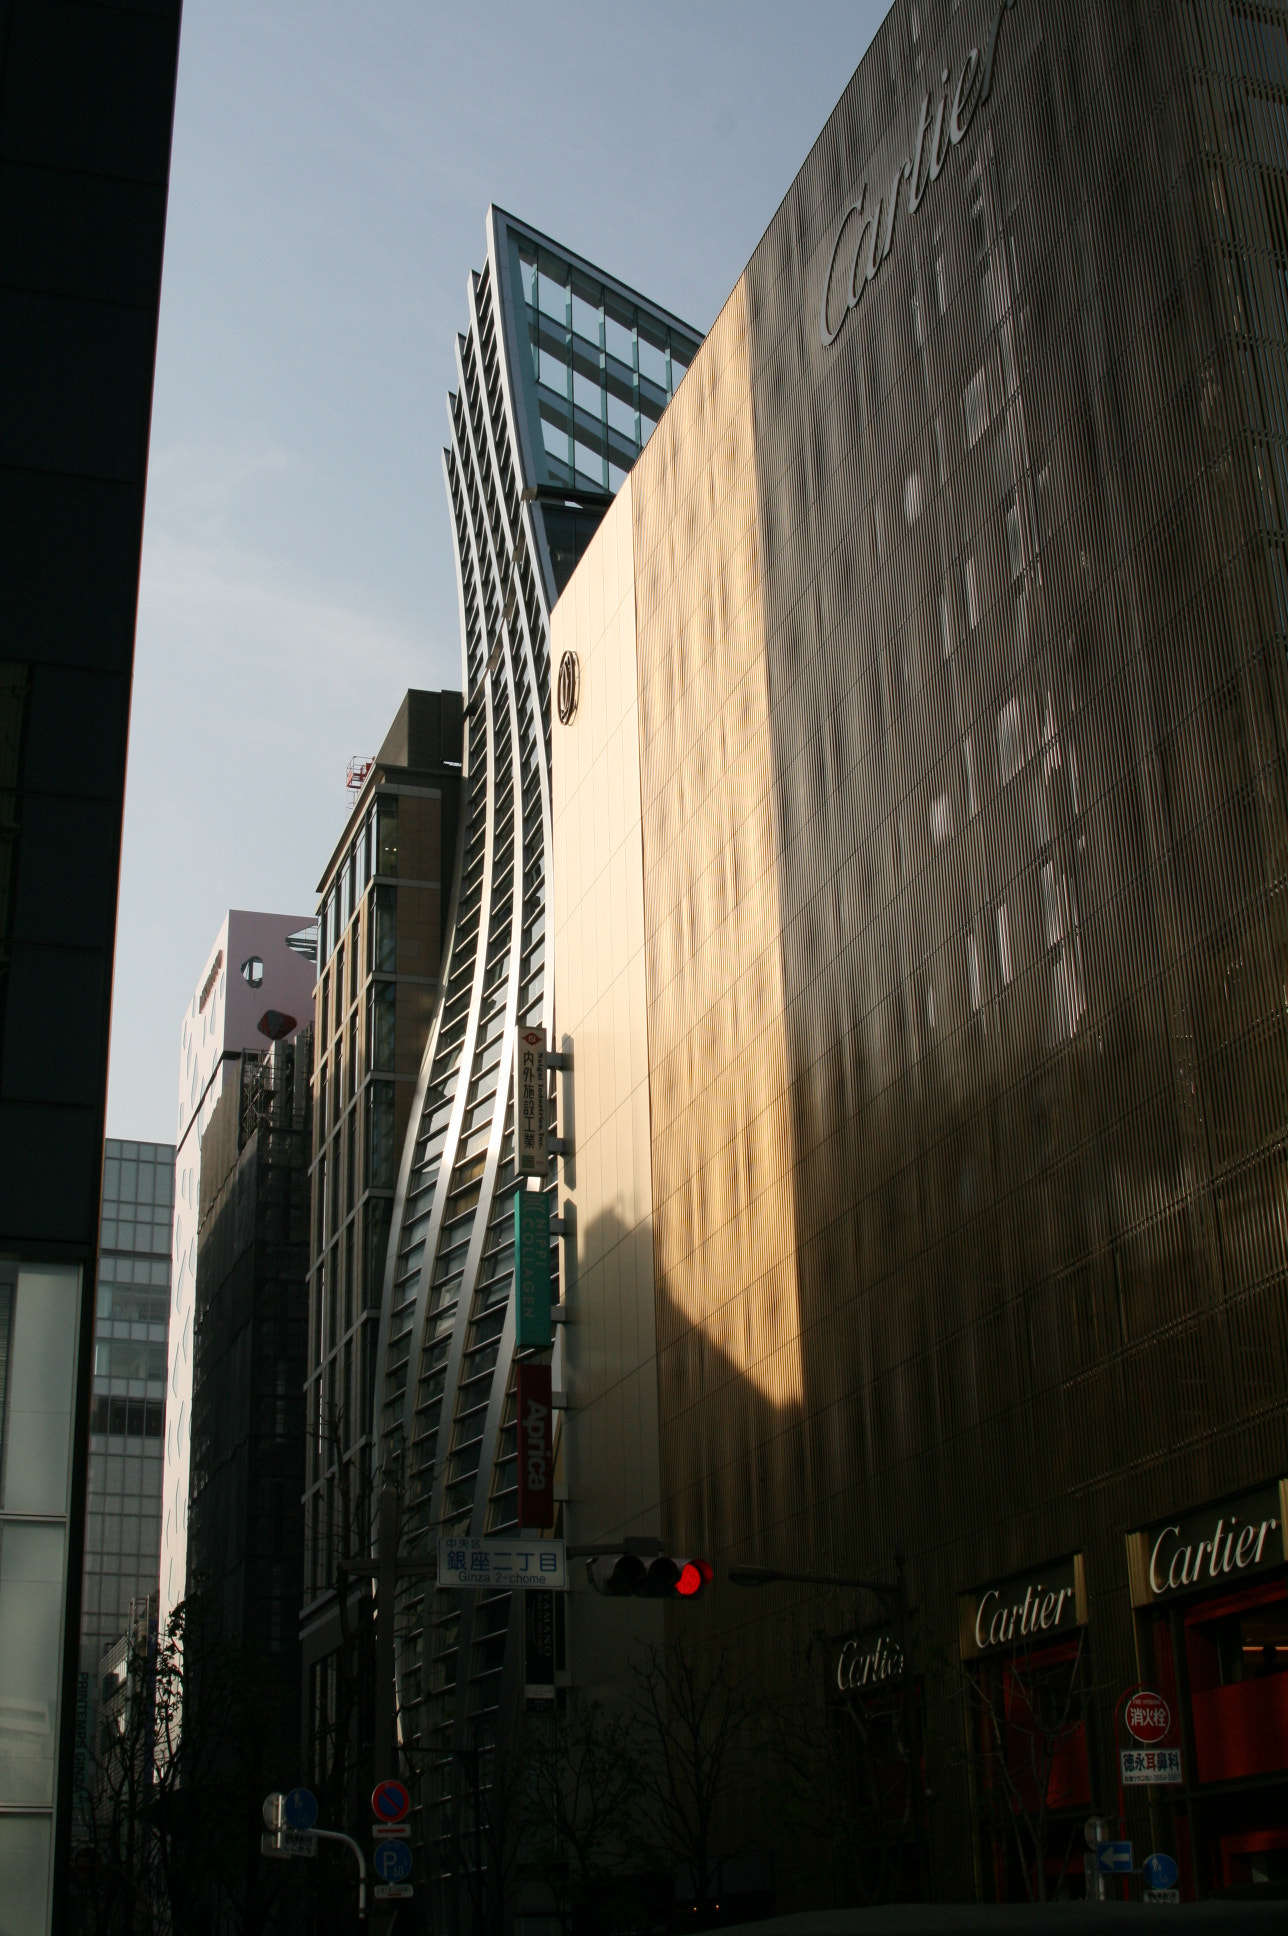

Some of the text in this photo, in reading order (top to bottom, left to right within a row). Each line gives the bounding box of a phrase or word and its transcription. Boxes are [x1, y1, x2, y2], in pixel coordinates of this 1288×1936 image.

[523, 1051, 535, 1149] 内外施設工業
[522, 1217, 536, 1319] COLLAGEN
[535, 1218, 548, 1266] NIPPI
[522, 1399, 552, 1491] Aprica
[446, 1538, 481, 1550] 中央区
[447, 1551, 557, 1572] 銀座二丁目
[1149, 1515, 1278, 1594] Cartier
[458, 1571, 546, 1584] Ginza 2-chome
[543, 1592, 552, 1657] YAMANO
[975, 1583, 1074, 1649] Cartier
[76, 1672, 89, 1748] PRINTEMPS
[1130, 1707, 1166, 1727] 消火栓
[1123, 1752, 1179, 1772] 徳永耳鼻科
